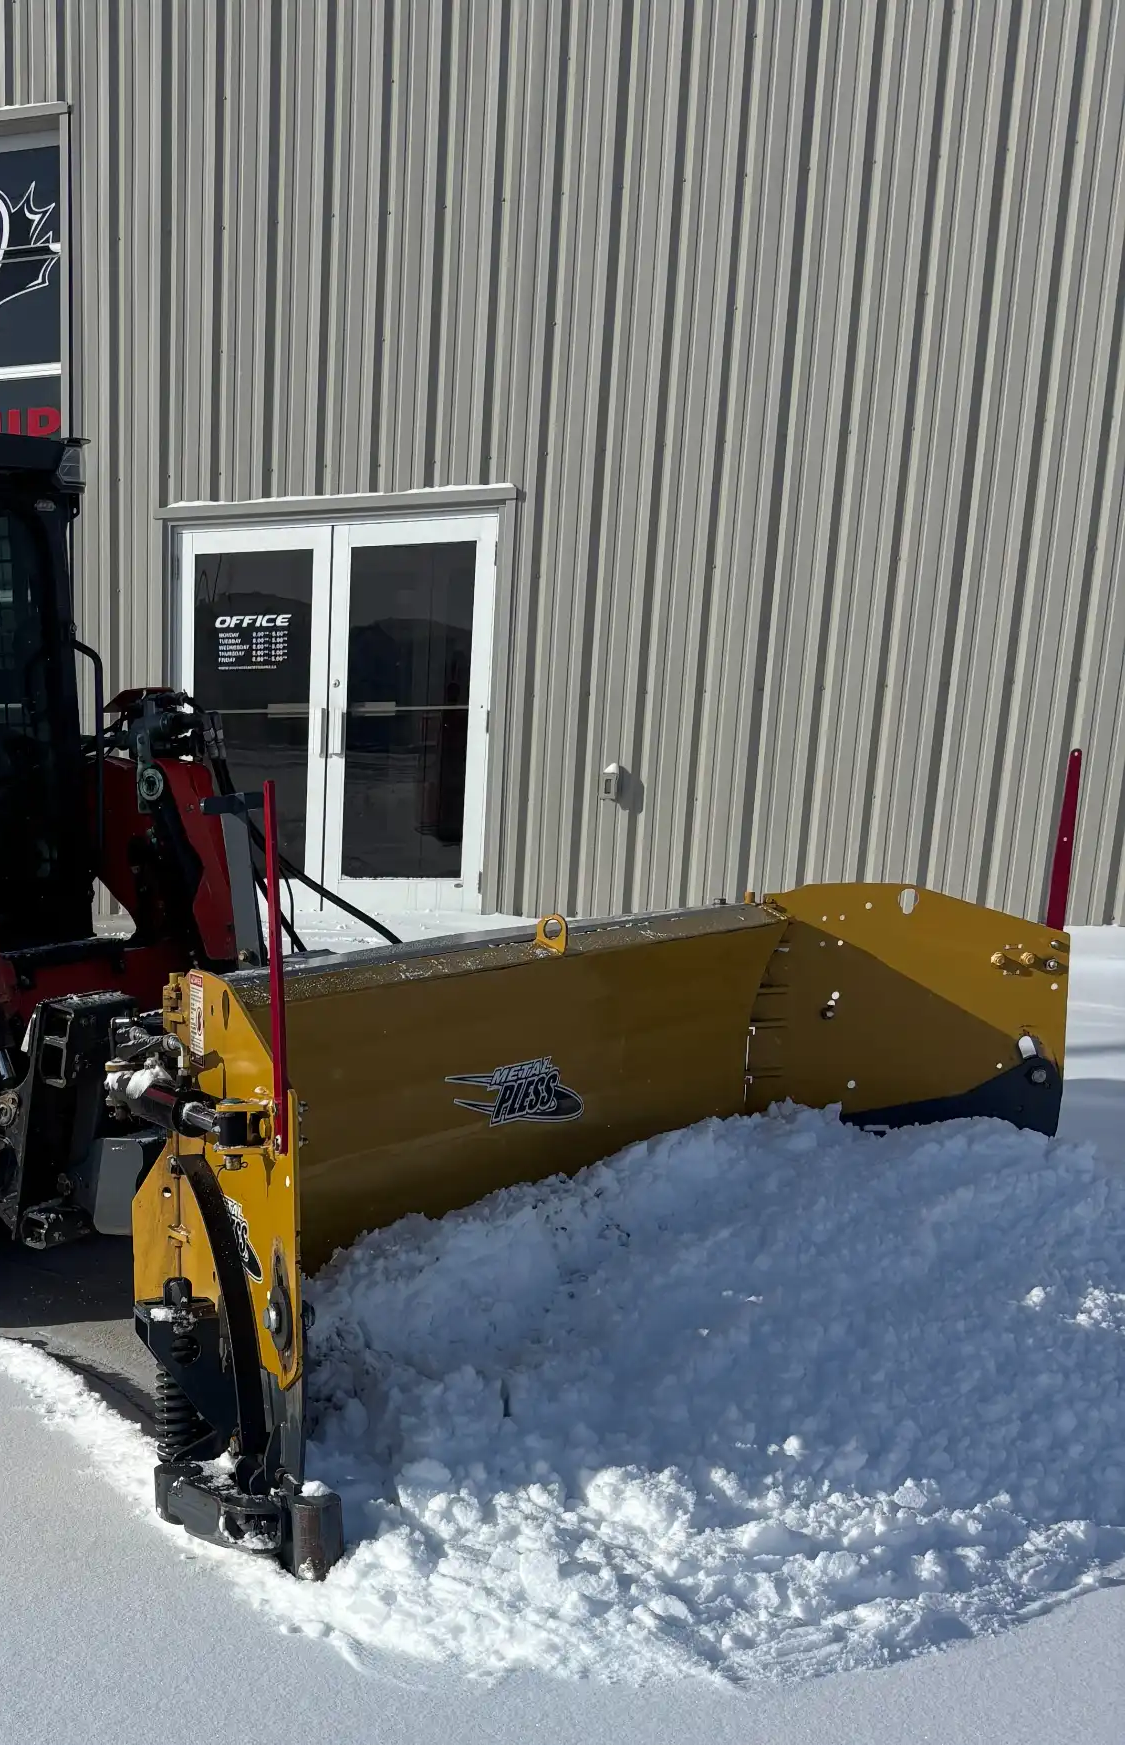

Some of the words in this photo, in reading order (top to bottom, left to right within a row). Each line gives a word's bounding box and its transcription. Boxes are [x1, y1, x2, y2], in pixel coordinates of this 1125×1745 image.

[215, 614, 292, 628] OFFICE
[491, 1056, 554, 1085] METAL
[491, 1070, 560, 1121] PLESS
